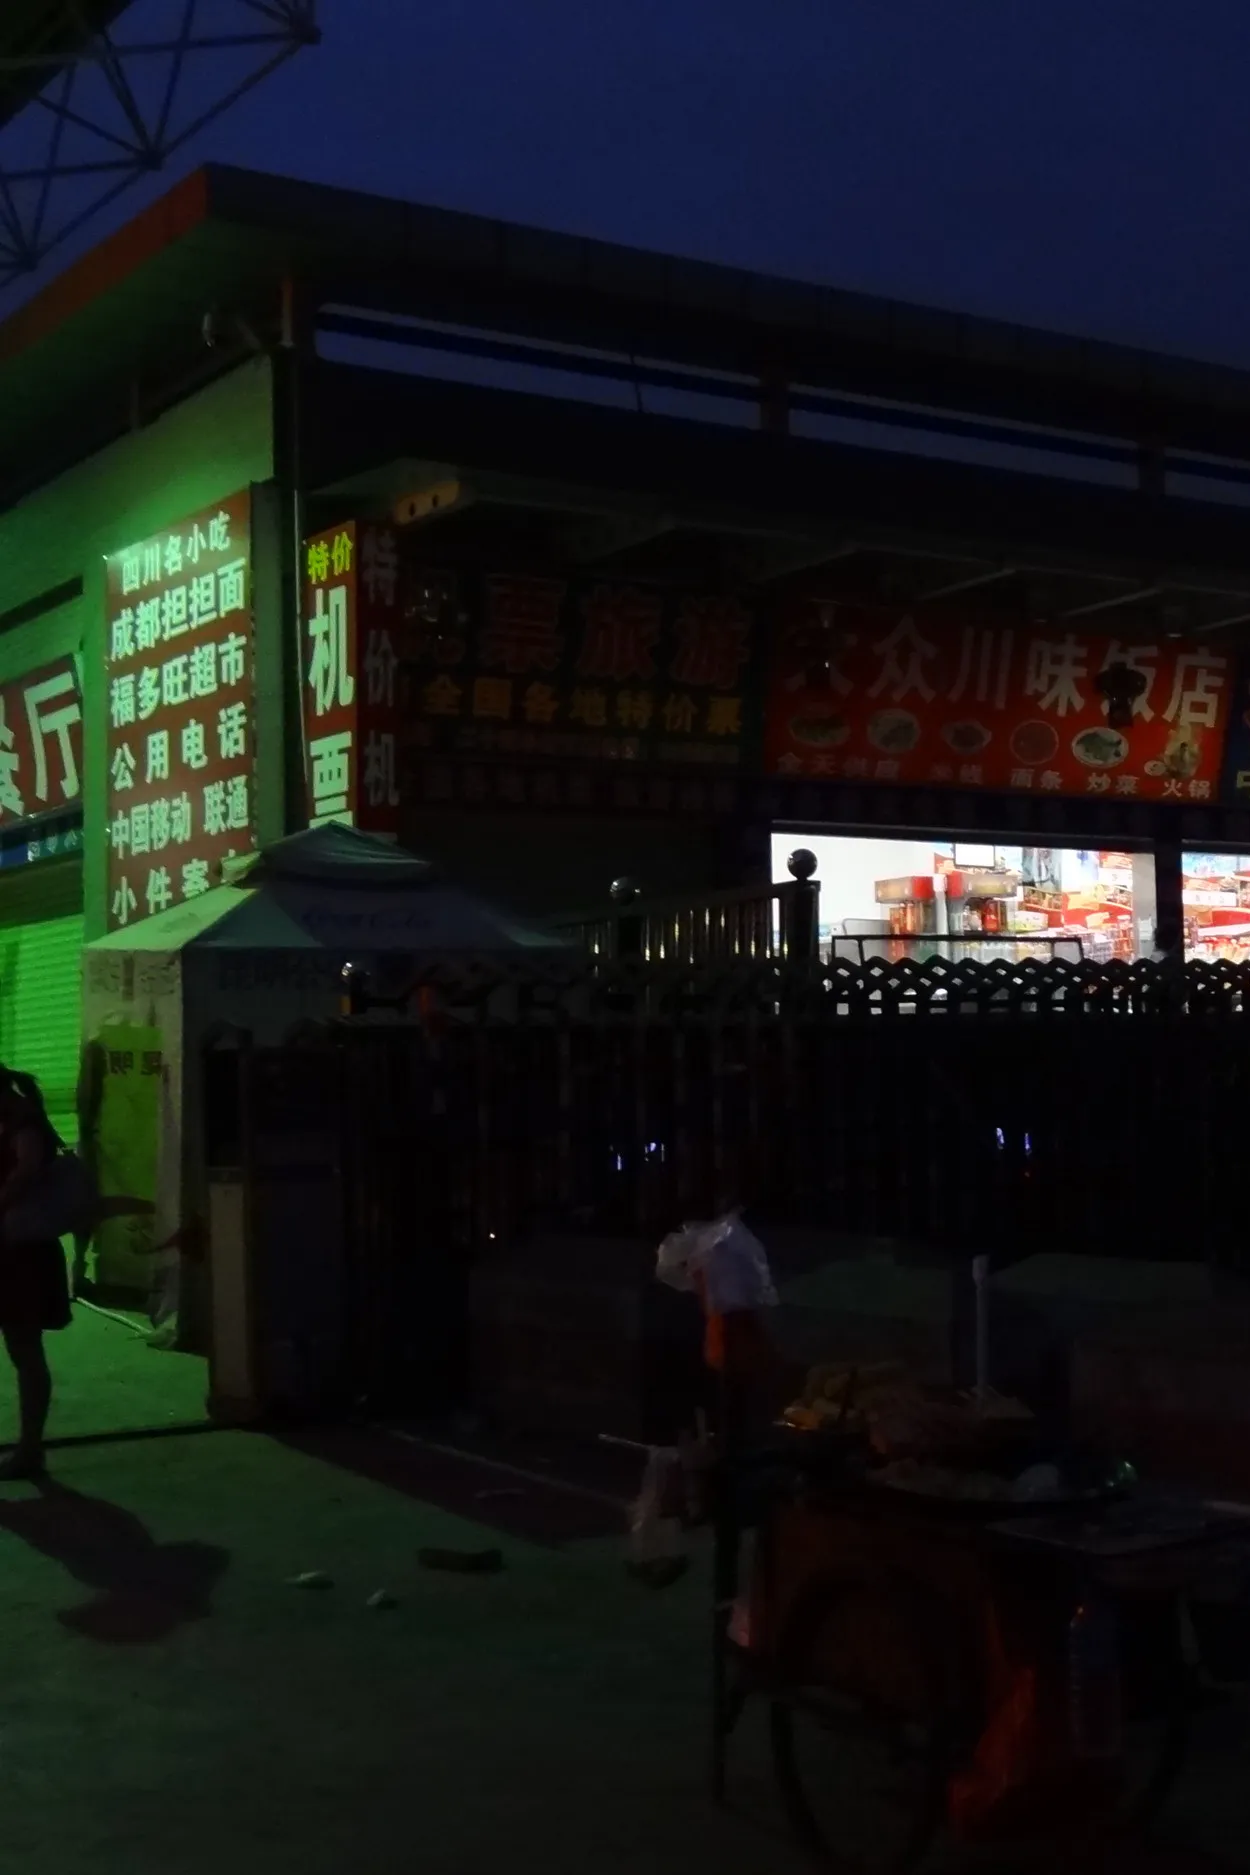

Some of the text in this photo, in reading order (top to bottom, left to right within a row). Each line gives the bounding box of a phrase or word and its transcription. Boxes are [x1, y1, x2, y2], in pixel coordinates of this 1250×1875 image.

[121, 510, 231, 595] 四川名小吃
[306, 530, 355, 585] 特价
[110, 557, 247, 662] 成都担担面
[110, 631, 248, 729] 福多旺超市
[110, 701, 248, 792] 公用电话
[1010, 767, 1063, 792] 面条
[1086, 771, 1139, 796] 炒菜
[1161, 777, 1212, 801] 火锅
[111, 791, 193, 860] 中国移动
[202, 774, 250, 837] 联通
